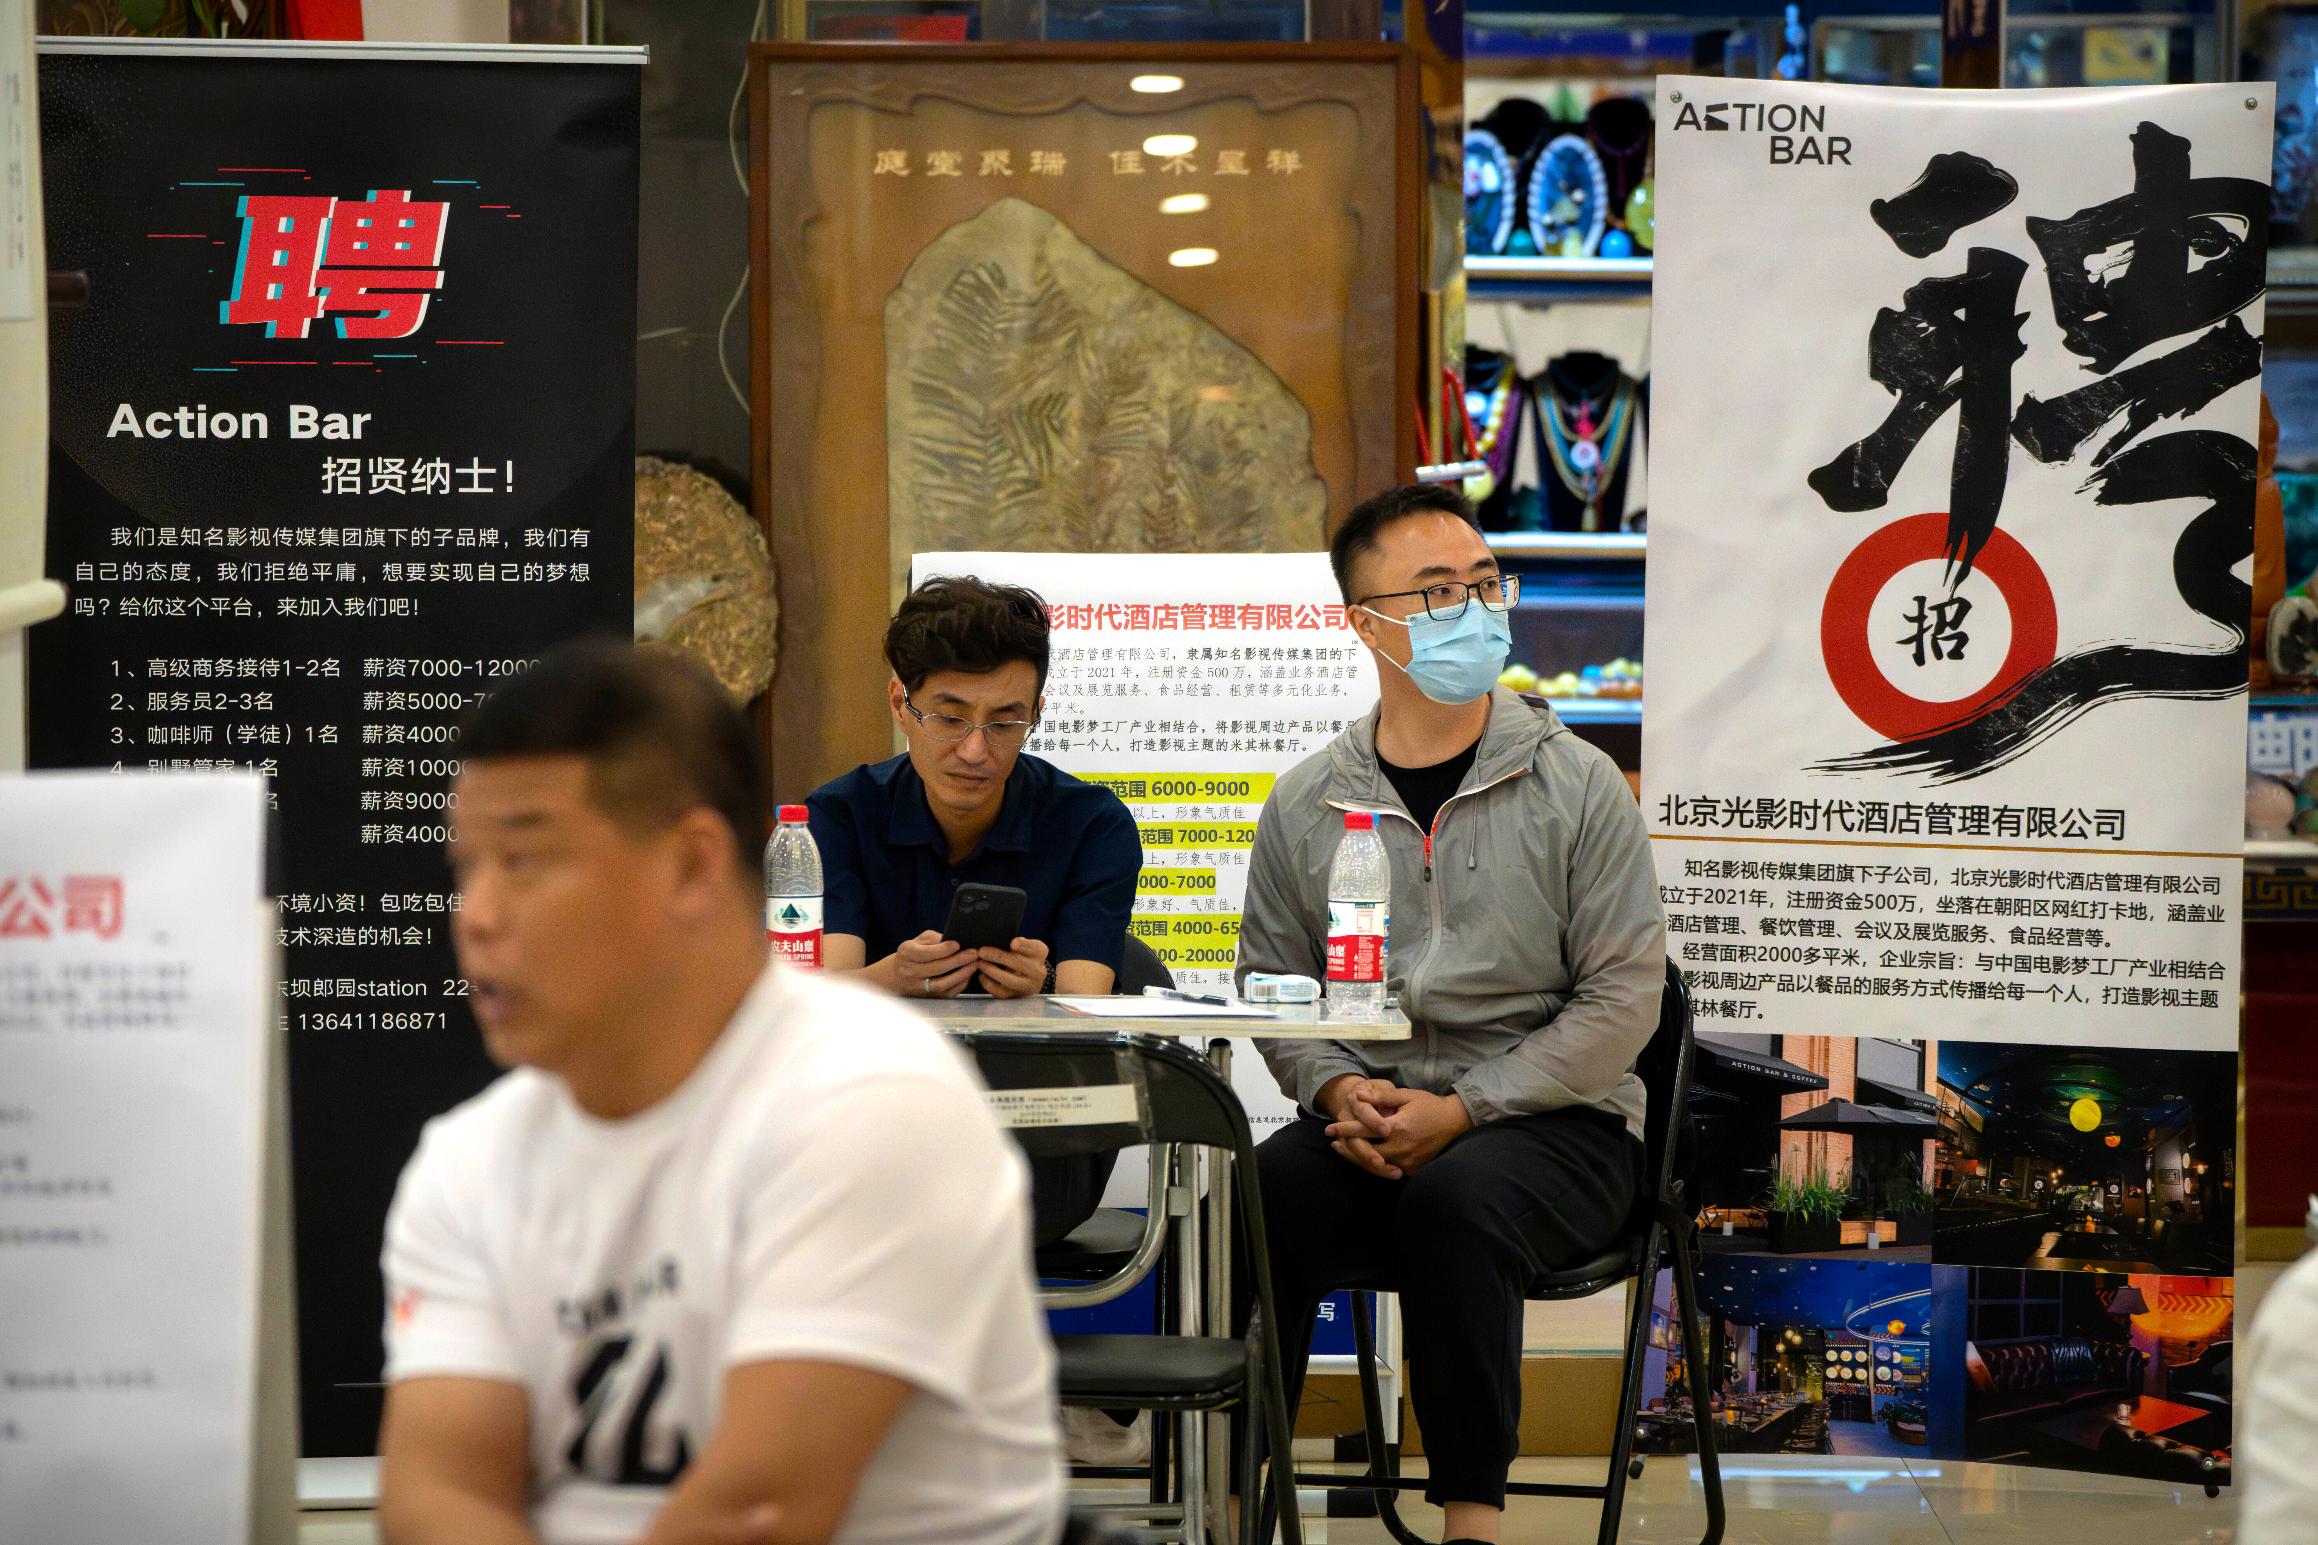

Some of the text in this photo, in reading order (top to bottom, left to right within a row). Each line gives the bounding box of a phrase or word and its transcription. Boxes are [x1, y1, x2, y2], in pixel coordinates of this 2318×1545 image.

[1770, 135, 1852, 165] BAR
[219, 190, 450, 339] 聘
[106, 403, 372, 440] Action Bar
[111, 527, 590, 549] 我们是知名影视传媒集团旗下的子品牌，我们有
[76, 562, 590, 583] 自己的态度，我们拒绝平庸，想要实现自己的梦想
[1895, 596, 1972, 667] 招
[363, 657, 542, 678] 薪资7000-1200
[363, 691, 497, 711] 薪资5000-7
[1151, 781, 1250, 797] 6000-9000
[1658, 793, 2126, 842] 北京光影时代酒店管理有限公司
[1138, 828, 1174, 845] 范围
[1685, 858, 2221, 896] 知名影视传媒集团旗下子公司，北京光影时代酒店管理有限公司
[1664, 913, 2113, 949] 酒店管理、餐饮管理、会议及展览服务、食品经营等。
[1154, 948, 1236, 963] 00-20000
[1682, 942, 2226, 981] 经营面积2000多平米，企业宗旨：与中国电影梦工厂产业相结合
[299, 1011, 447, 1031] 13641186871
